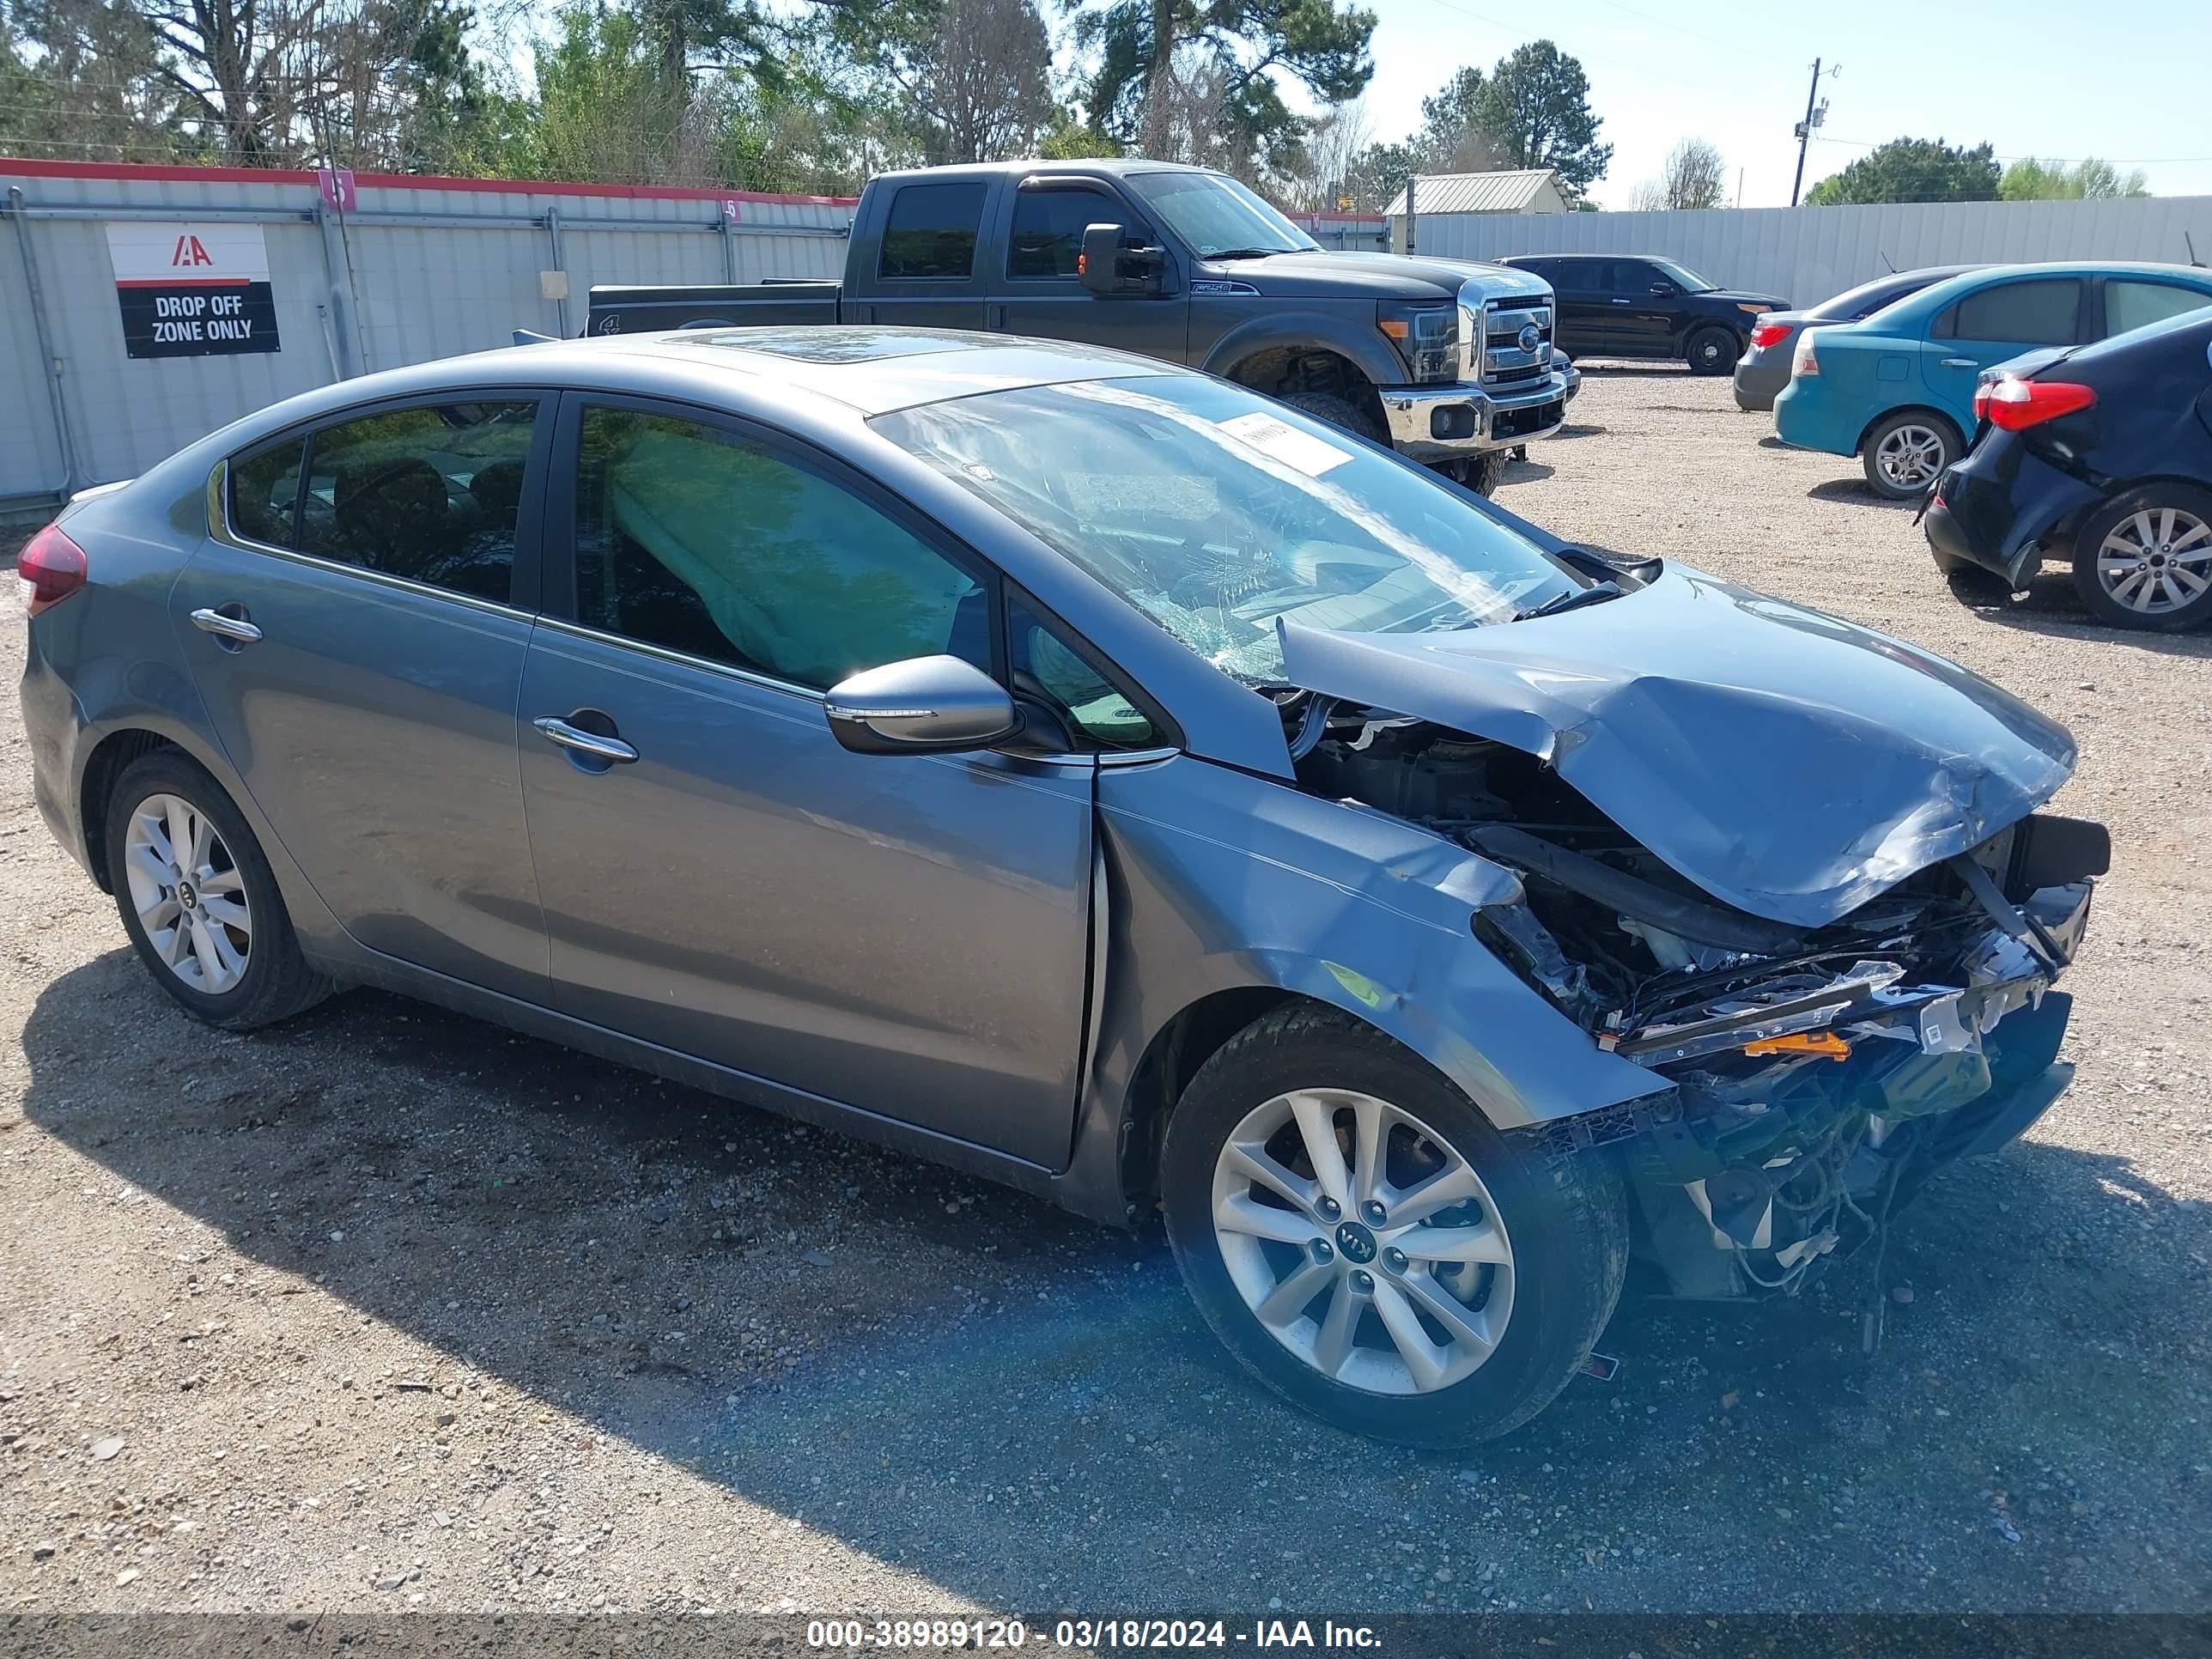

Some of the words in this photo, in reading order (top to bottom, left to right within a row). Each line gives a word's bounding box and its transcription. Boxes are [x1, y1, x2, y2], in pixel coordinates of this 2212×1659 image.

[155, 297, 206, 317] DROP
[211, 295, 242, 315] OFF
[152, 321, 204, 343] ZONE
[207, 319, 252, 340] ONLY
